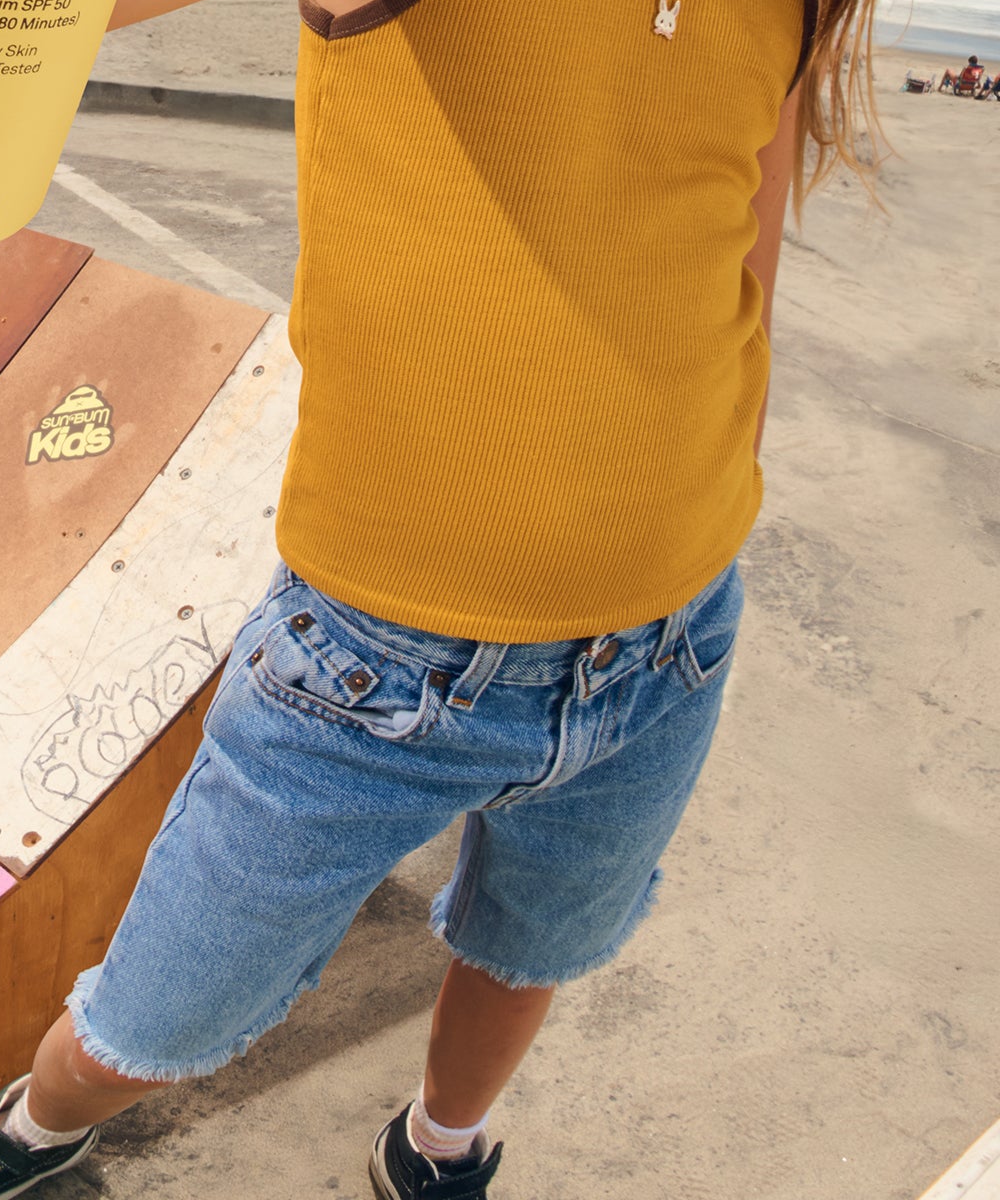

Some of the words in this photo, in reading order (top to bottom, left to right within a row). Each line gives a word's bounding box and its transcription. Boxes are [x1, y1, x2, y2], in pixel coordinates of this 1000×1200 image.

[20, 11, 81, 30] Minutes)
[5, 44, 38, 57] Skin
[27, 423, 111, 464] Kids
